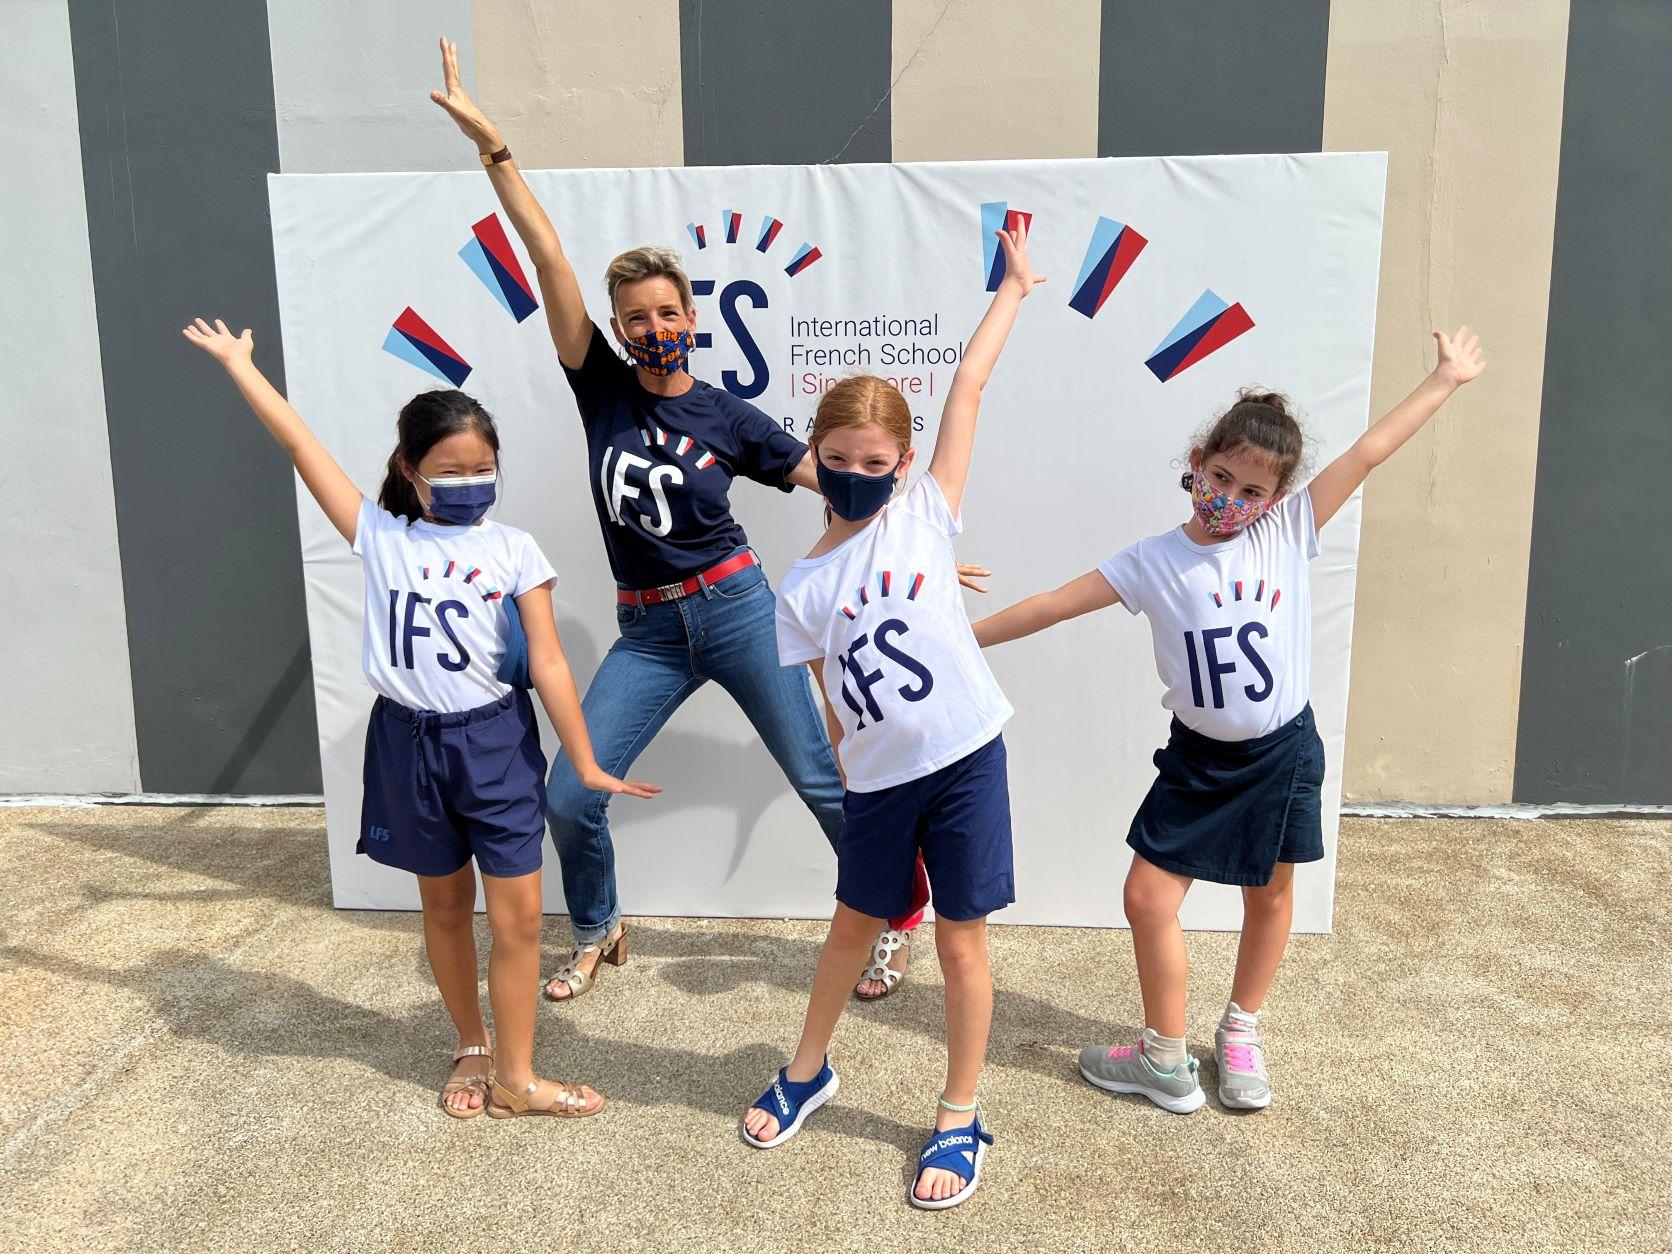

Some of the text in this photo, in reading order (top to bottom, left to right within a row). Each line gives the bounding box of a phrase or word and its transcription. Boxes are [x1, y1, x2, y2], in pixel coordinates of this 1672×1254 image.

[790, 313, 938, 337] International
[791, 341, 962, 366] French School
[802, 373, 922, 395] Sinore
[601, 446, 683, 537] IFS
[389, 589, 471, 672] IFS
[838, 618, 934, 731] IFS
[1183, 621, 1274, 709] IFS
[920, 1135, 973, 1161] new balance
